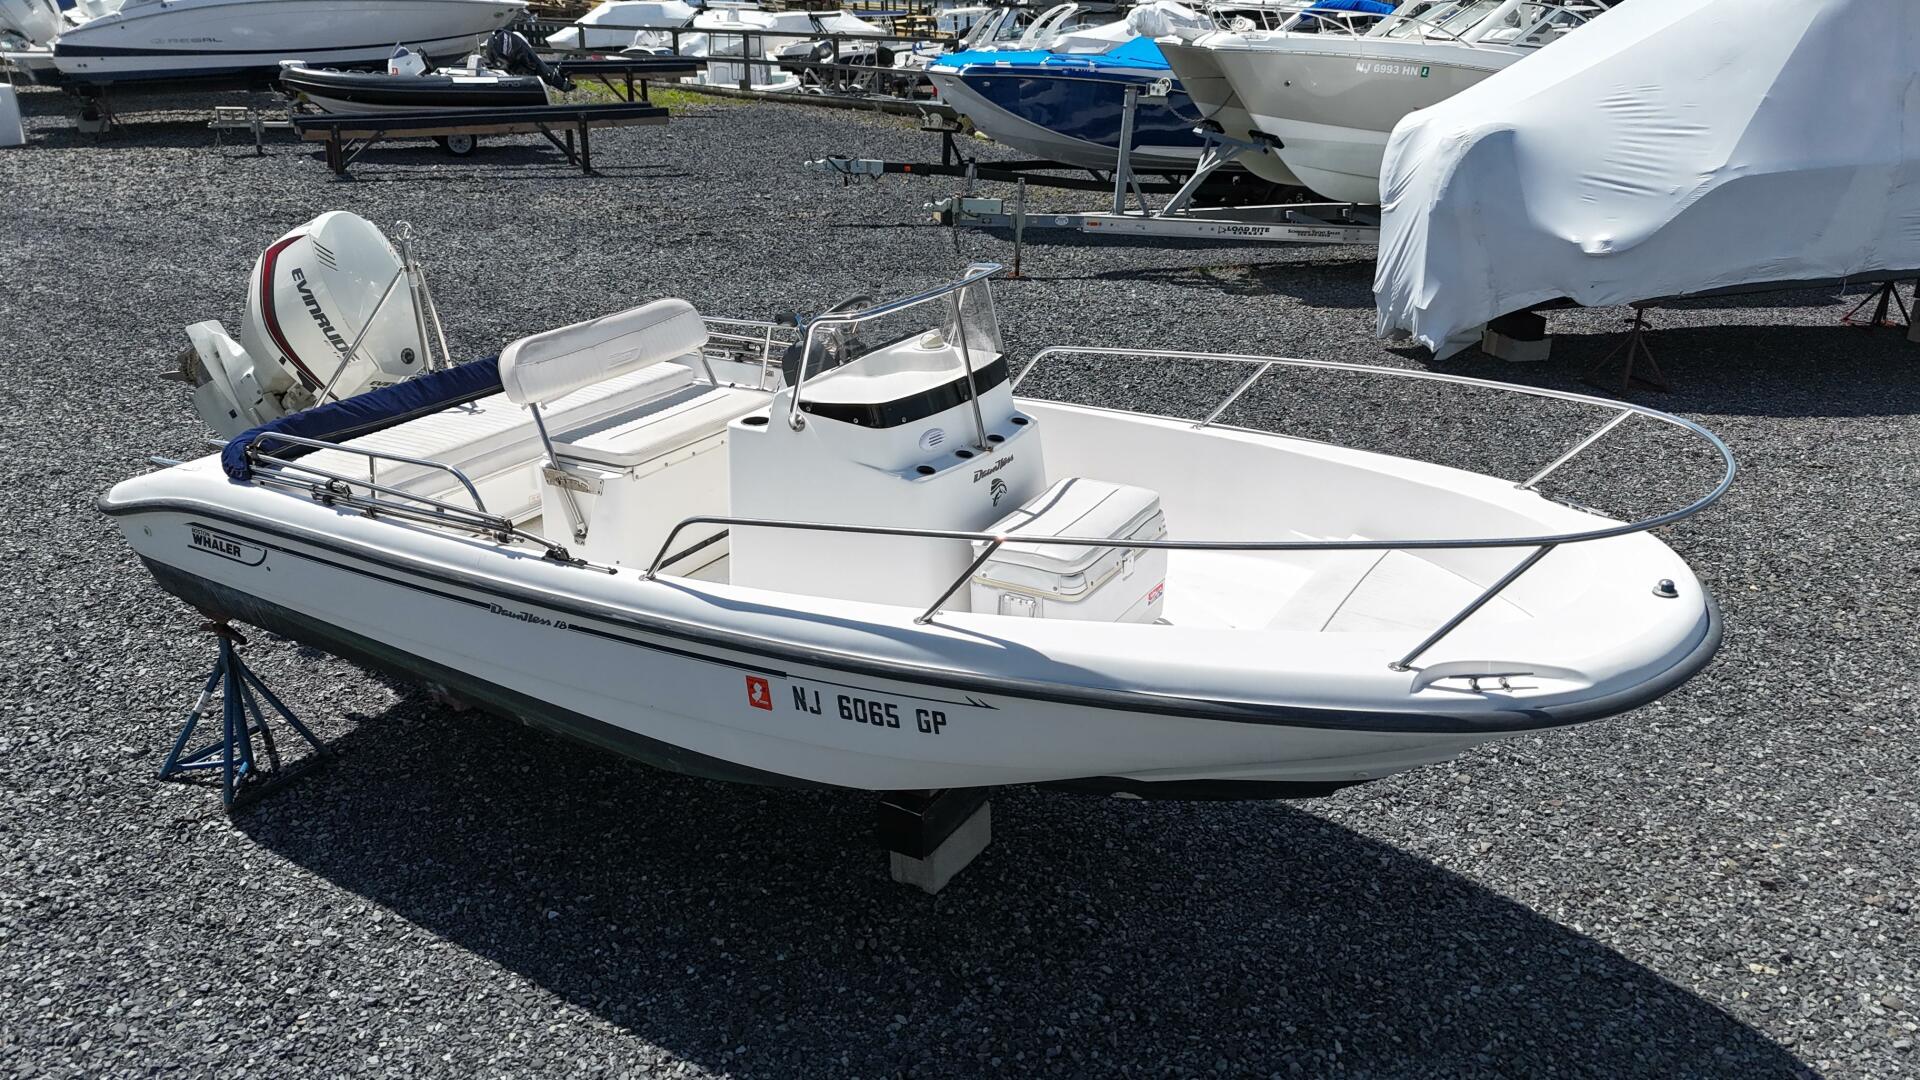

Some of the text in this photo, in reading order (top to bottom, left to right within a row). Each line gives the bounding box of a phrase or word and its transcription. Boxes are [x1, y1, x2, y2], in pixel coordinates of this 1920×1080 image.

[1355, 62, 1419, 76] NJ 6993 HN
[192, 532, 242, 558] WHALER
[490, 602, 567, 630] Dauntless 18
[792, 685, 947, 735] NJ 6065 GP
